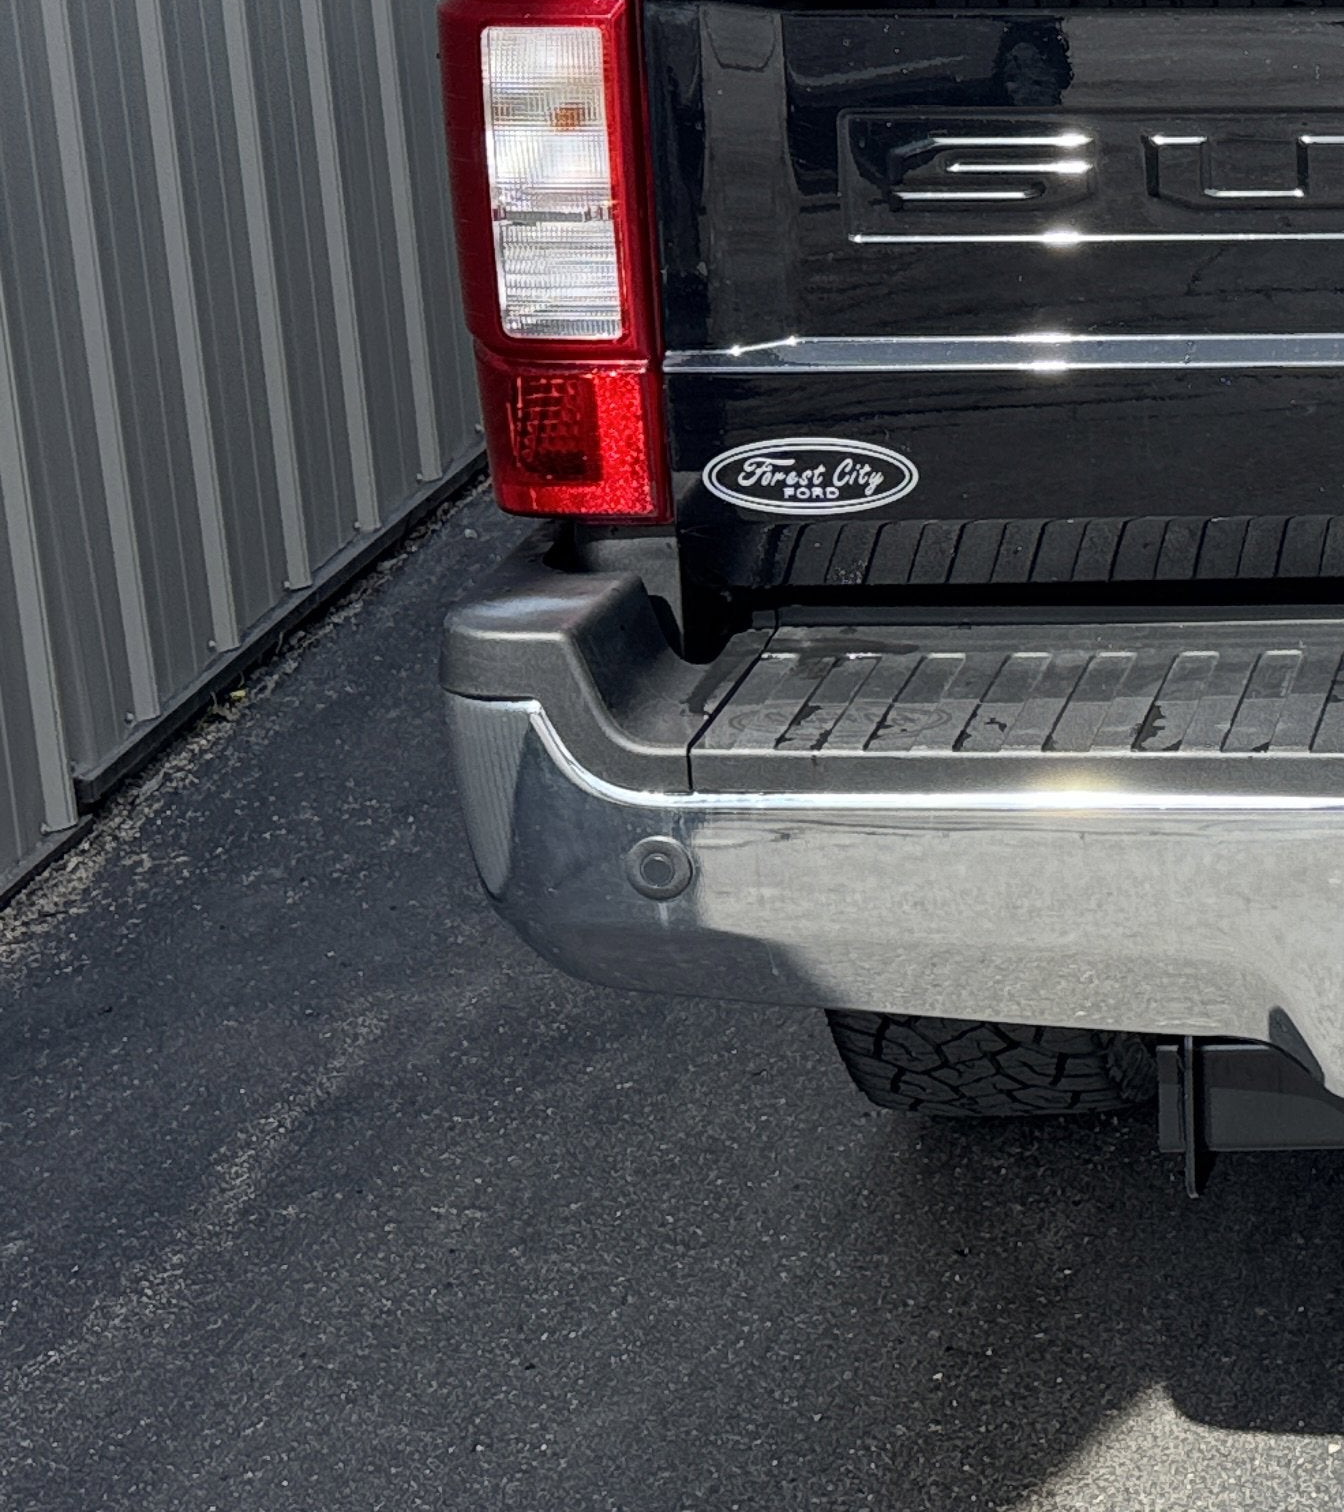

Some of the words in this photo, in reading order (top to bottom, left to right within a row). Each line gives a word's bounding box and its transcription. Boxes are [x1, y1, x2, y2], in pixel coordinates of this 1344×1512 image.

[737, 456, 826, 486] Forest
[832, 457, 885, 496] City
[783, 486, 840, 499] FORD
